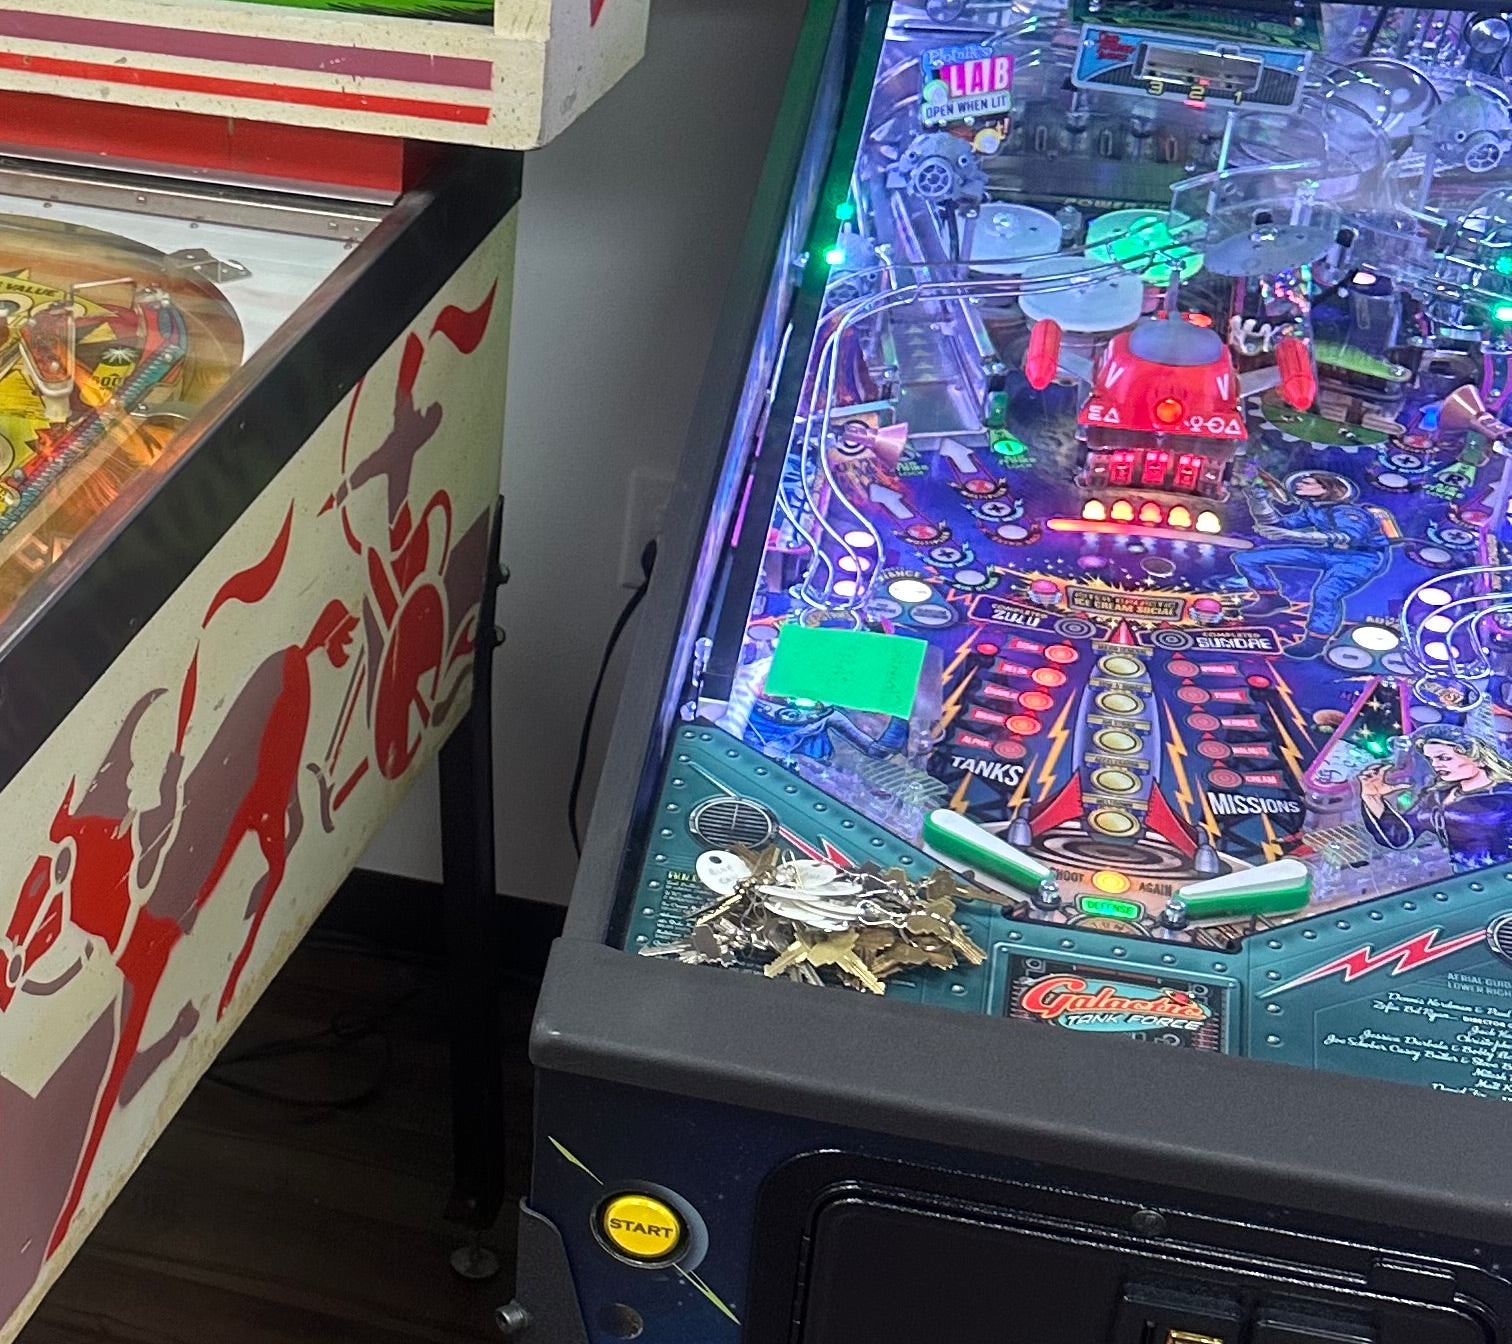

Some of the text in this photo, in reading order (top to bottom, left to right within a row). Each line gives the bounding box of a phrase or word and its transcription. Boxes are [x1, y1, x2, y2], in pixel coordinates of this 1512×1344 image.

[947, 55, 1010, 97] LAB
[1148, 81, 1242, 104] 3 2 1
[926, 95, 1008, 119] OPEN WHEN LIT
[5, 281, 59, 297] VALUE
[991, 609, 1042, 627] ZULU
[1135, 603, 1174, 617] SOCIAL
[1195, 636, 1273, 650] SUNDAE
[1202, 630, 1261, 639] COMPLETED
[951, 755, 1025, 787] TANKS
[1206, 791, 1302, 815] MISSIONS
[1138, 881, 1173, 897] AGAIN
[1019, 974, 1209, 1020] Galactic
[1066, 1012, 1206, 1032] TANK FORCE
[607, 1216, 675, 1243] START
